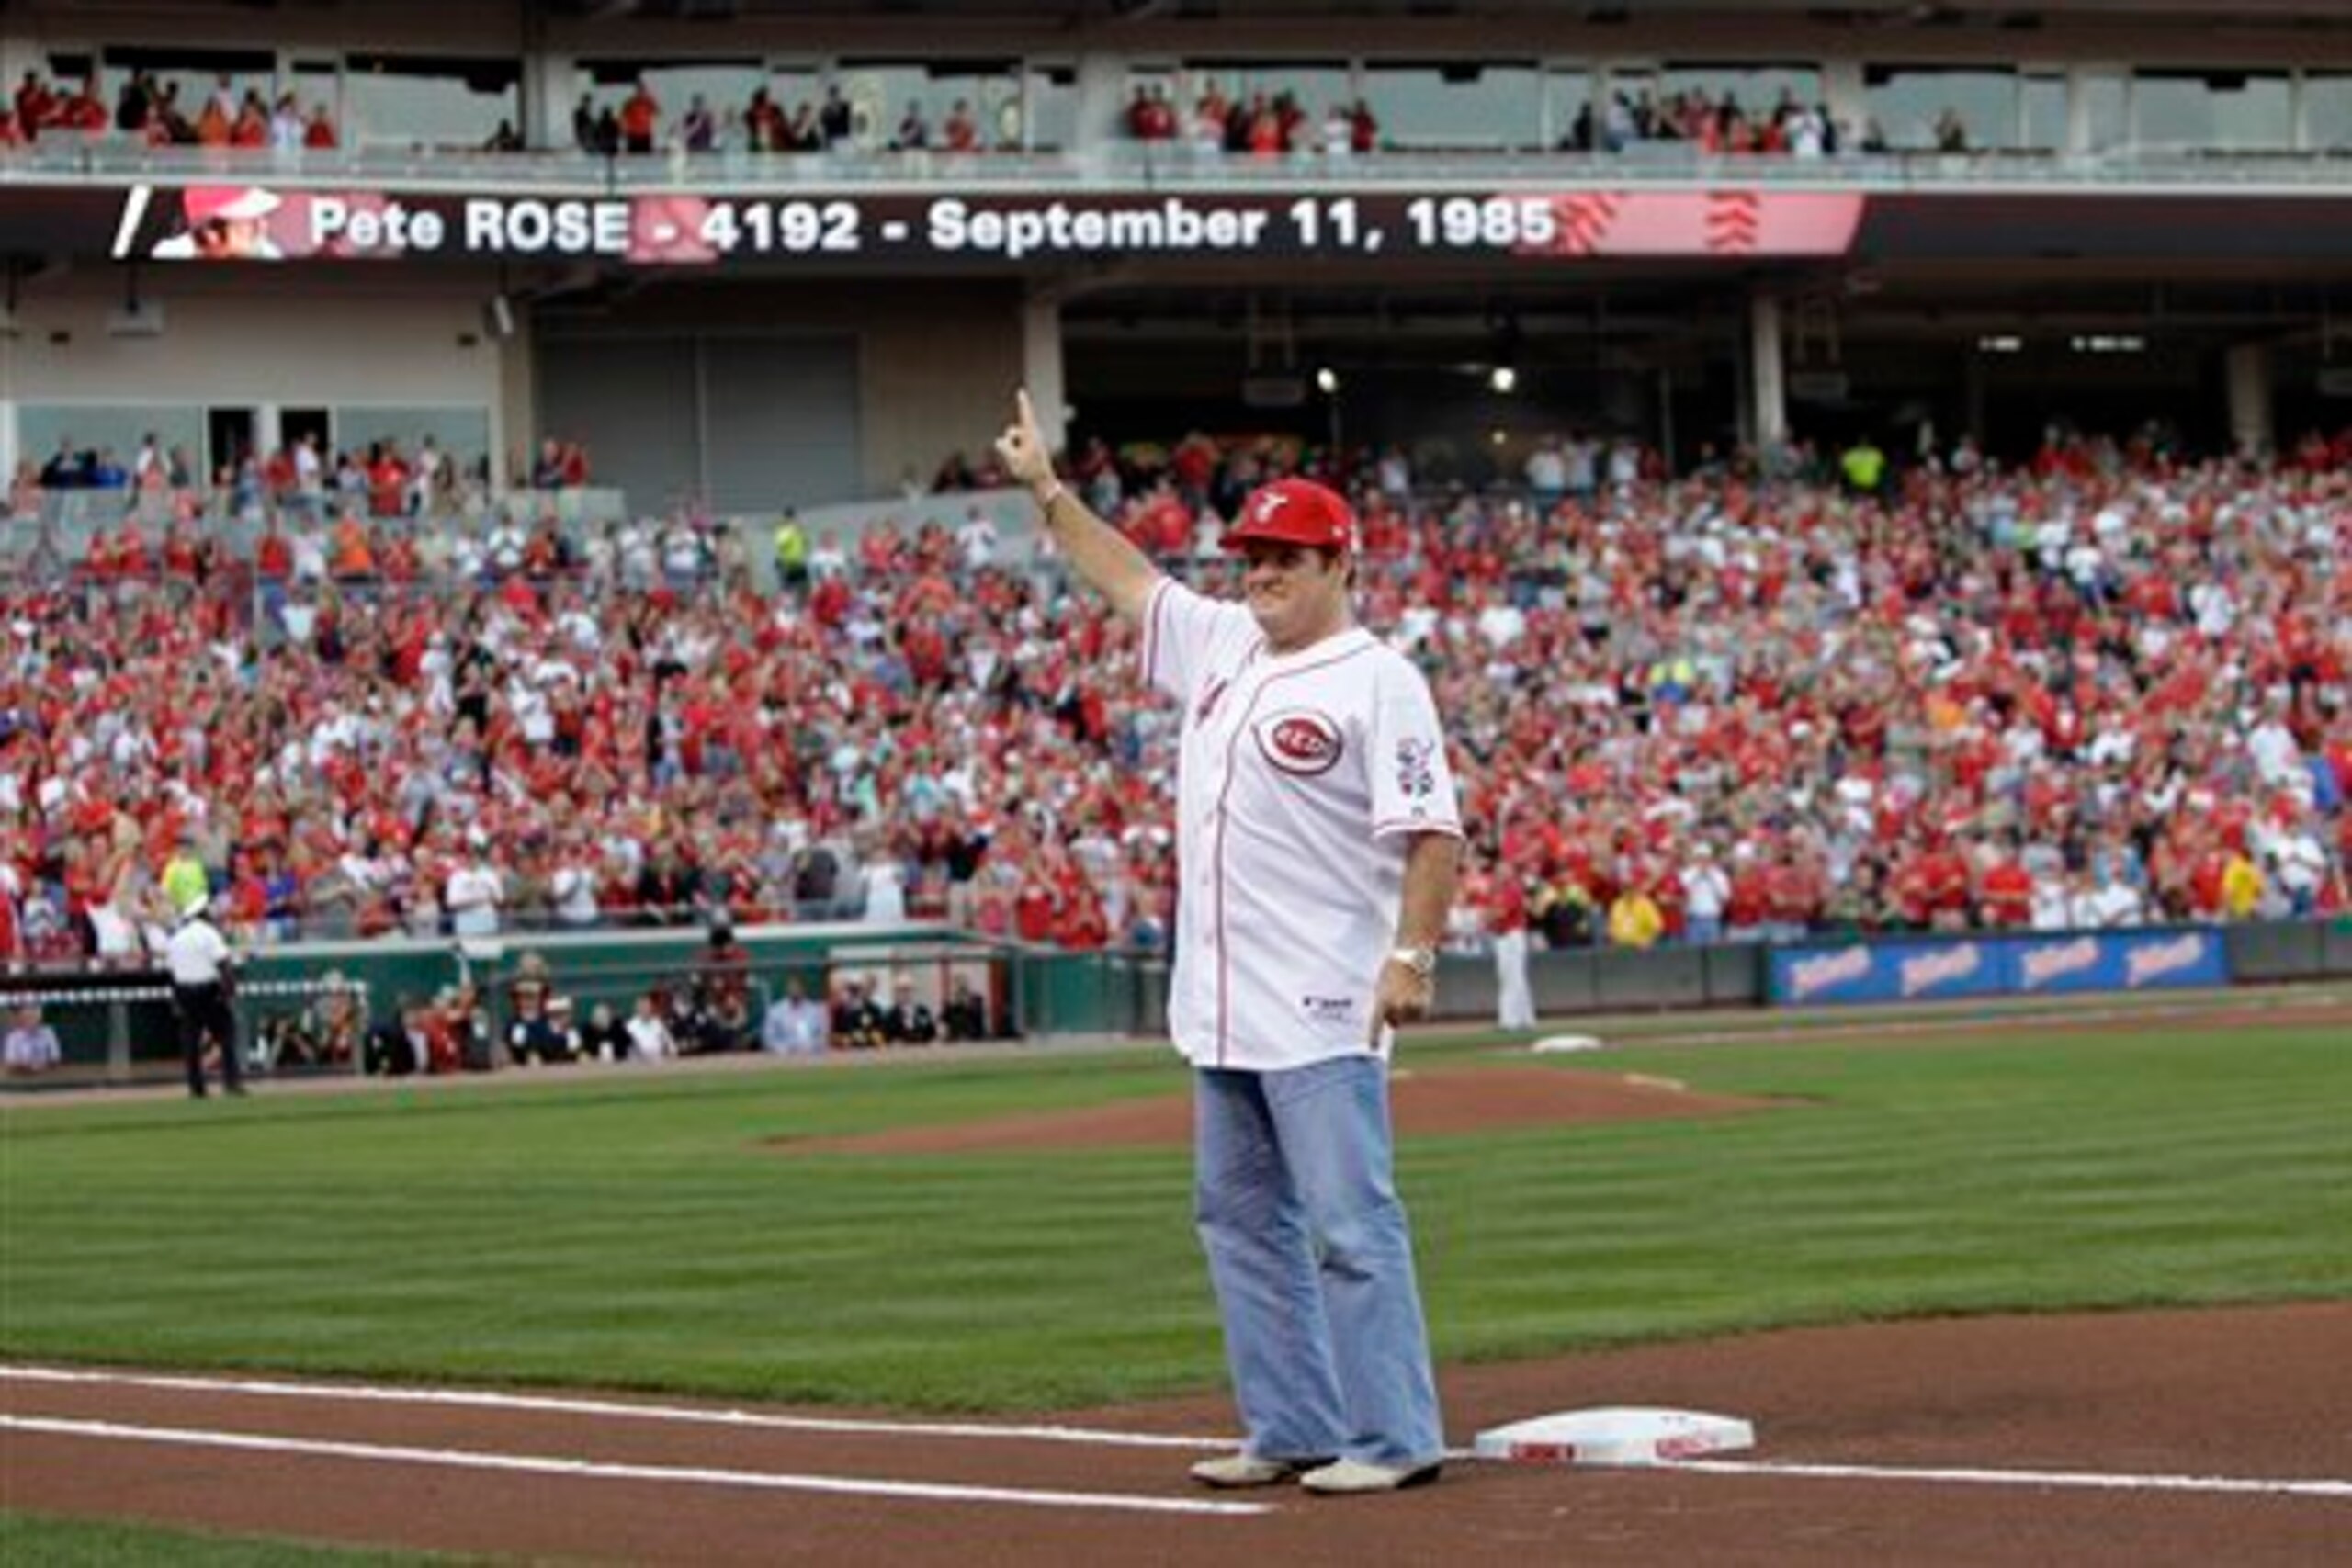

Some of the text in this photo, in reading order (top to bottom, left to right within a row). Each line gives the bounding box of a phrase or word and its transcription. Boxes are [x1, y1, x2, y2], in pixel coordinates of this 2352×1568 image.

[307, 197, 443, 247] Pete
[466, 200, 630, 249] ROSE
[699, 202, 860, 249] 4192
[929, 200, 1266, 255] September
[1291, 199, 1380, 248] 11,
[1408, 198, 1555, 243] 1985
